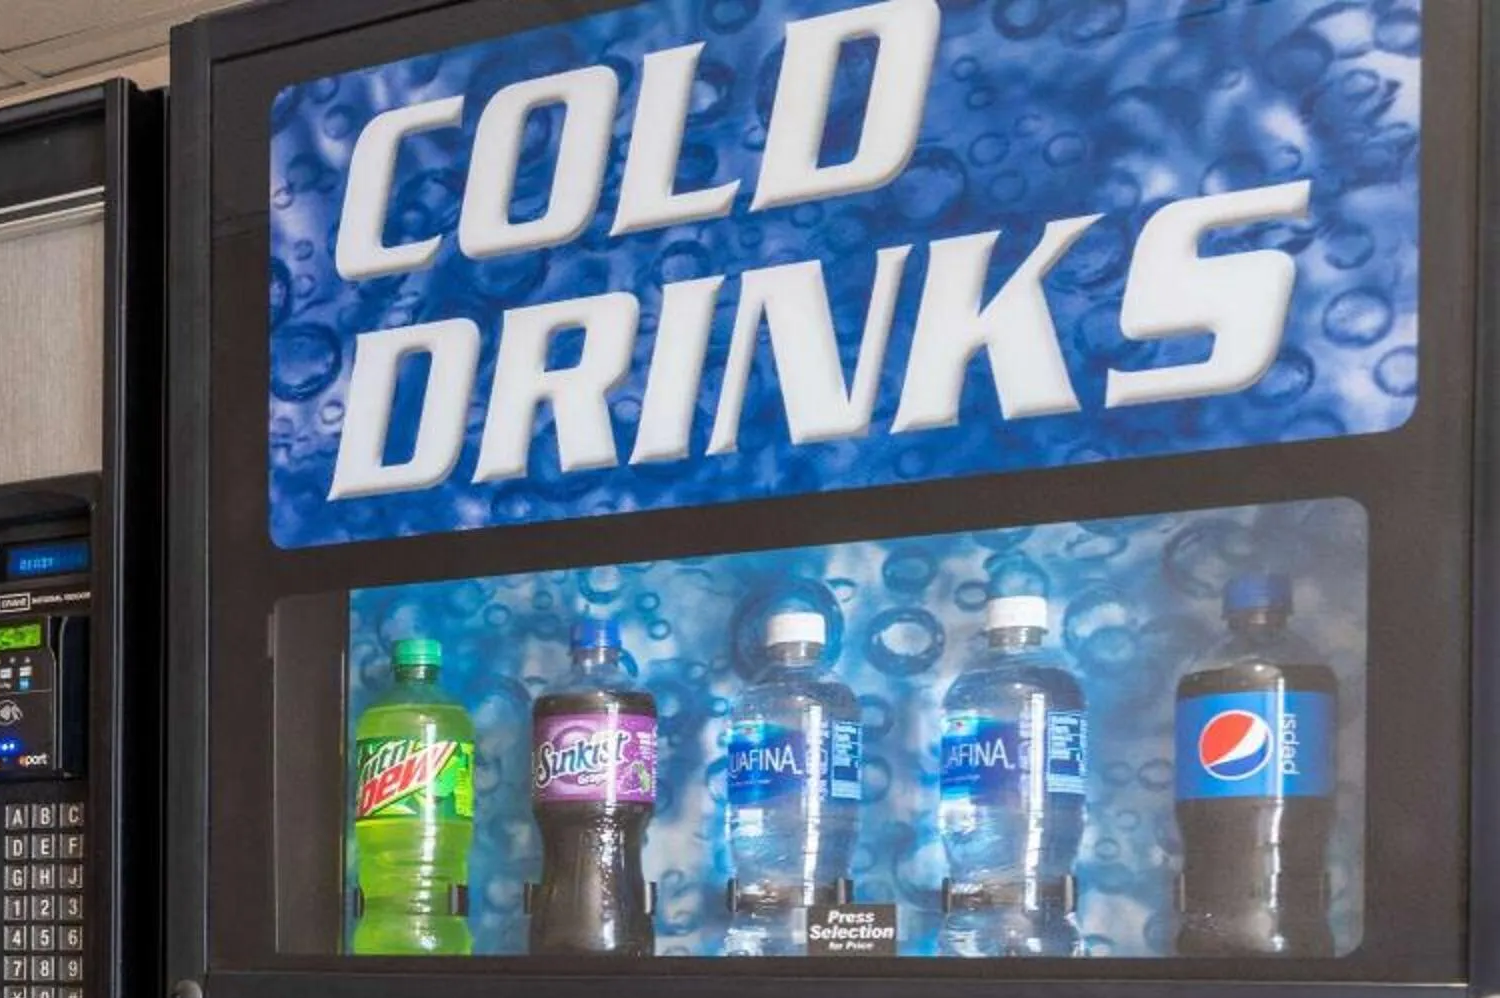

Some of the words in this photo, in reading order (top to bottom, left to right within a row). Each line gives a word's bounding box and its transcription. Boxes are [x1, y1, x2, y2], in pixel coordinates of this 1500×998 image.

[336, 0, 942, 281] COLD
[327, 180, 1311, 501] DRINKS
[12, 808, 23, 825] A
[40, 808, 51, 825] B
[68, 807, 79, 823] C
[12, 839, 23, 857] D
[40, 838, 50, 855] E
[68, 838, 78, 854] F
[12, 870, 23, 887] G
[39, 868, 50, 884] H
[67, 868, 77, 885] J
[12, 900, 21, 916] 1
[40, 899, 50, 915] 2
[68, 899, 77, 915] 3
[828, 910, 876, 925] Press
[12, 930, 21, 946] 4
[40, 929, 50, 946] 5
[68, 929, 77, 946] 6
[809, 924, 895, 940] Selection
[828, 941, 844, 951] for
[846, 941, 874, 951] Price
[12, 961, 22, 978] 7
[40, 961, 50, 977] 8
[68, 960, 77, 977] 9
